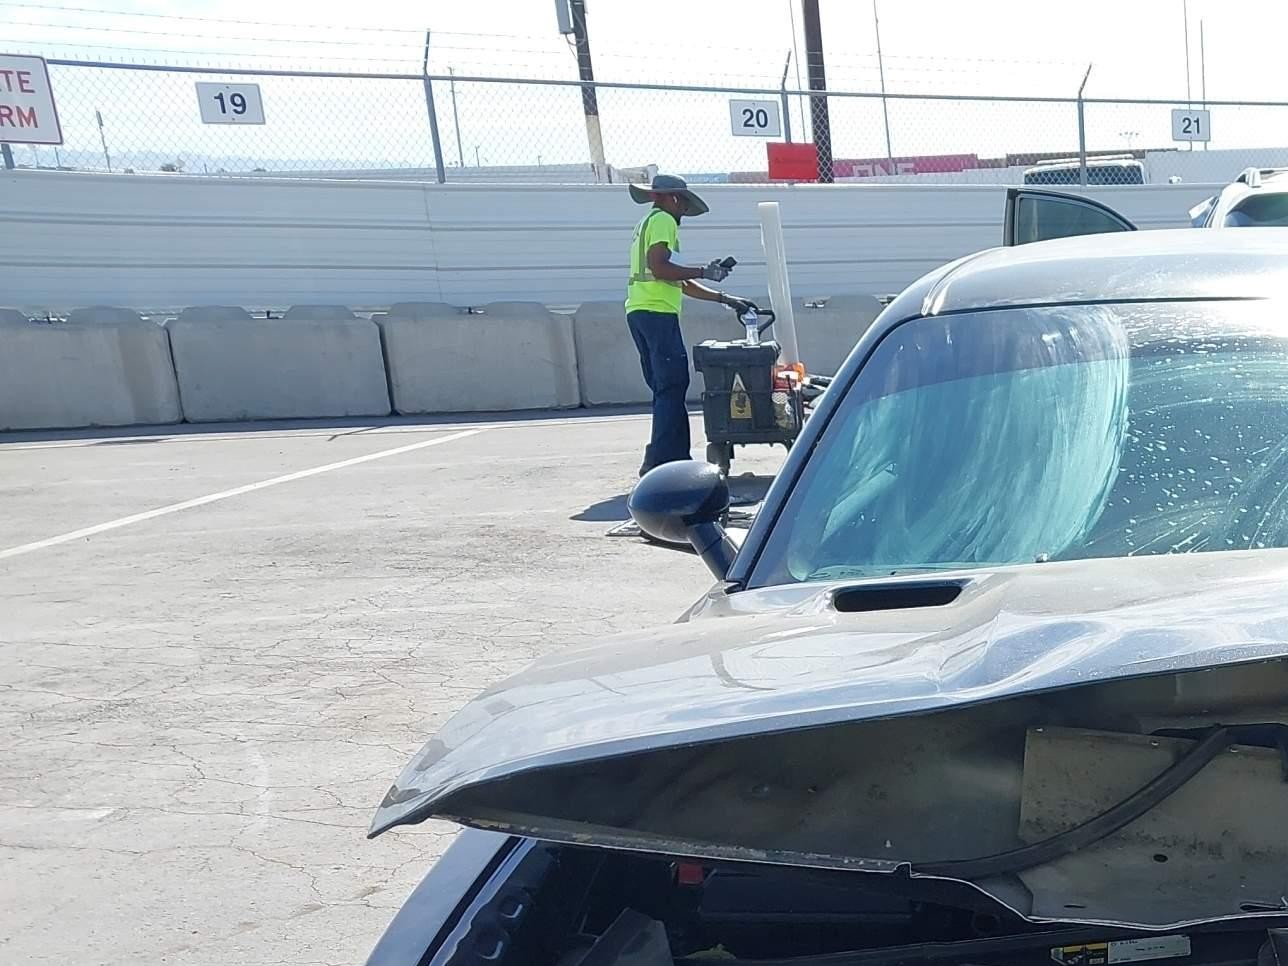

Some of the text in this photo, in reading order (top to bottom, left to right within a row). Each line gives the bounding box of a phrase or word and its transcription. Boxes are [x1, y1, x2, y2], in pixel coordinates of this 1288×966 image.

[0, 70, 36, 93] TE
[213, 92, 247, 115] 19
[742, 108, 769, 129] 20
[1182, 117, 1200, 134] 21
